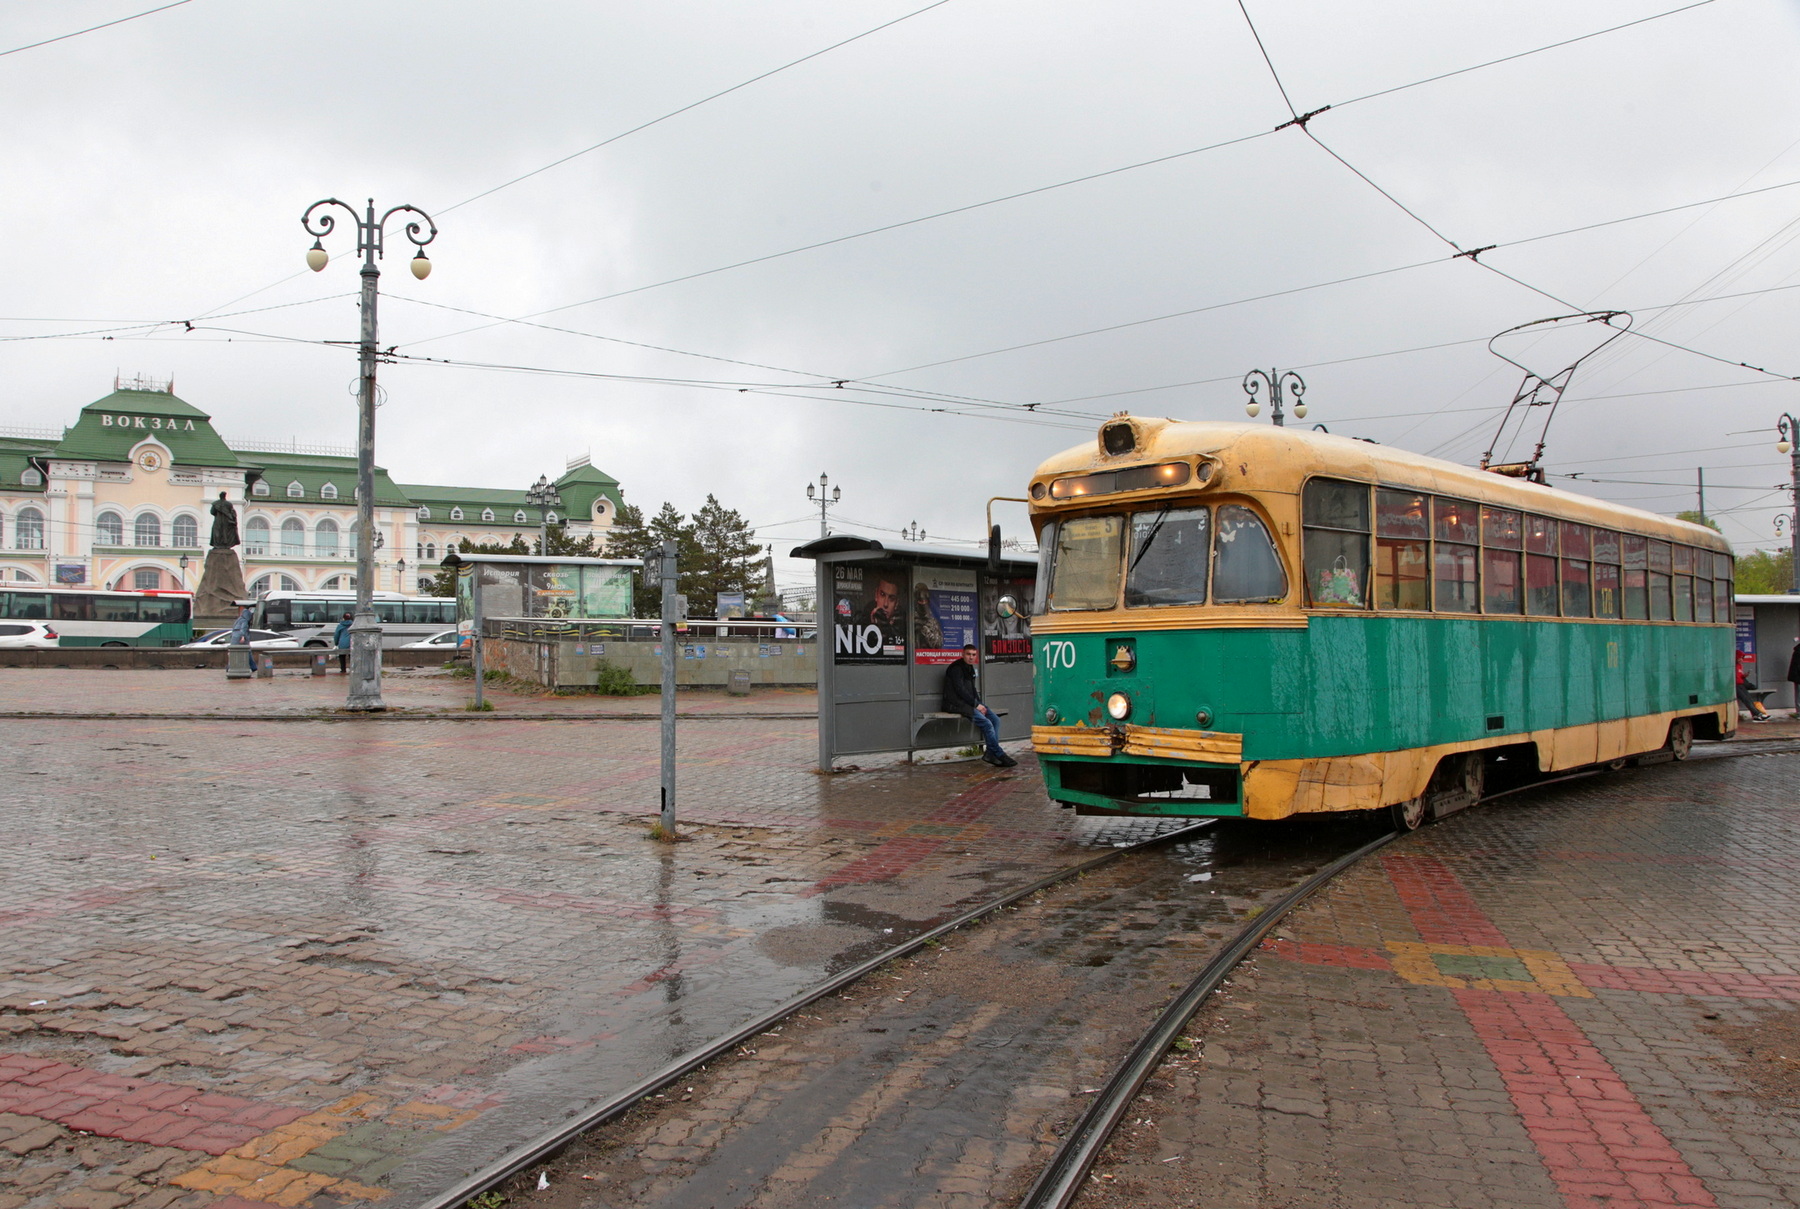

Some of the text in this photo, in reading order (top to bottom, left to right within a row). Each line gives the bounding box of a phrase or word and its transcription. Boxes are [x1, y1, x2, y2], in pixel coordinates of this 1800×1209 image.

[101, 414, 195, 431] ВОКЗАЛ
[1105, 519, 1112, 533] 5
[483, 568, 520, 577] История
[835, 566, 863, 580] 26 МАЯ
[1601, 587, 1613, 614] 170
[951, 604, 960, 612] 210
[895, 635, 904, 645] 16+
[991, 639, 1031, 654] БЛИЗОСТЬ
[1042, 641, 1076, 669] 170
